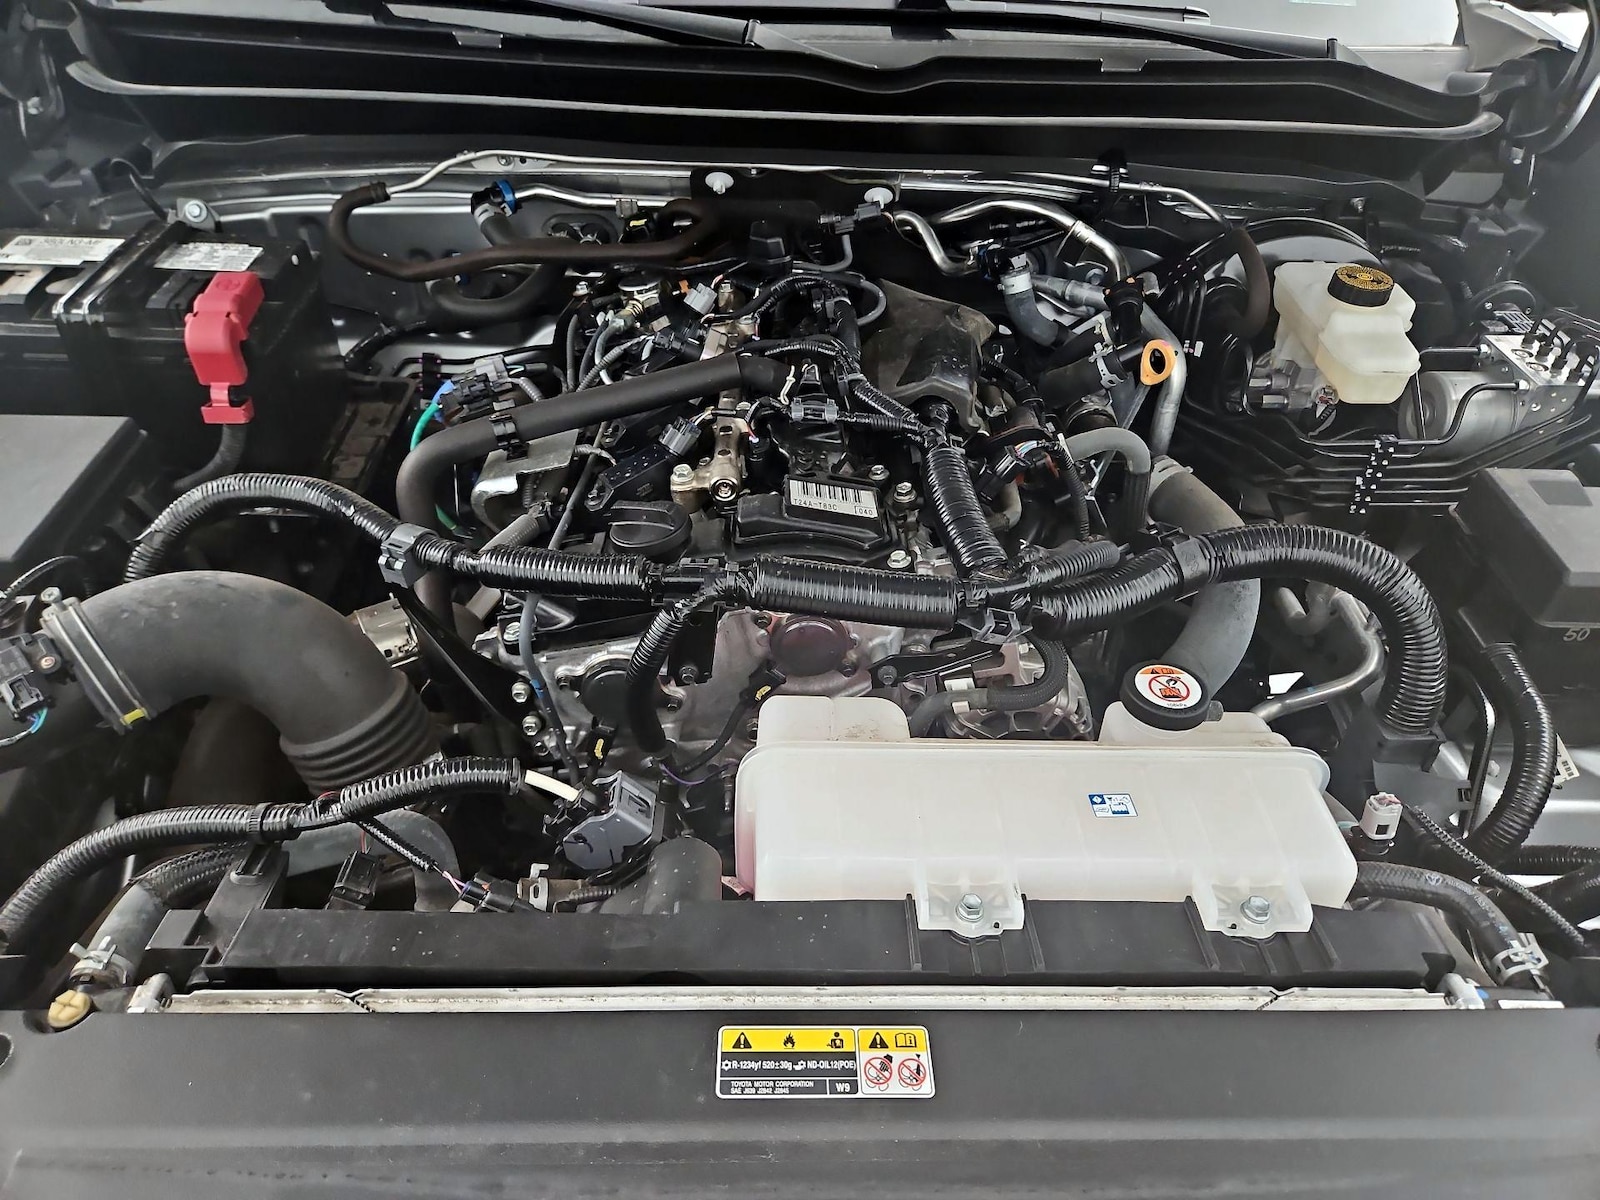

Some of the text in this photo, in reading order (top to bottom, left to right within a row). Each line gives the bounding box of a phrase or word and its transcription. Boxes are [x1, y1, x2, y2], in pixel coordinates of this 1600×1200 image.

[1563, 627, 1591, 641] 50
[762, 1060, 793, 1071] 520±30g
[807, 1060, 857, 1071] ND-OIL12(POE)
[835, 1082, 851, 1093] W9
